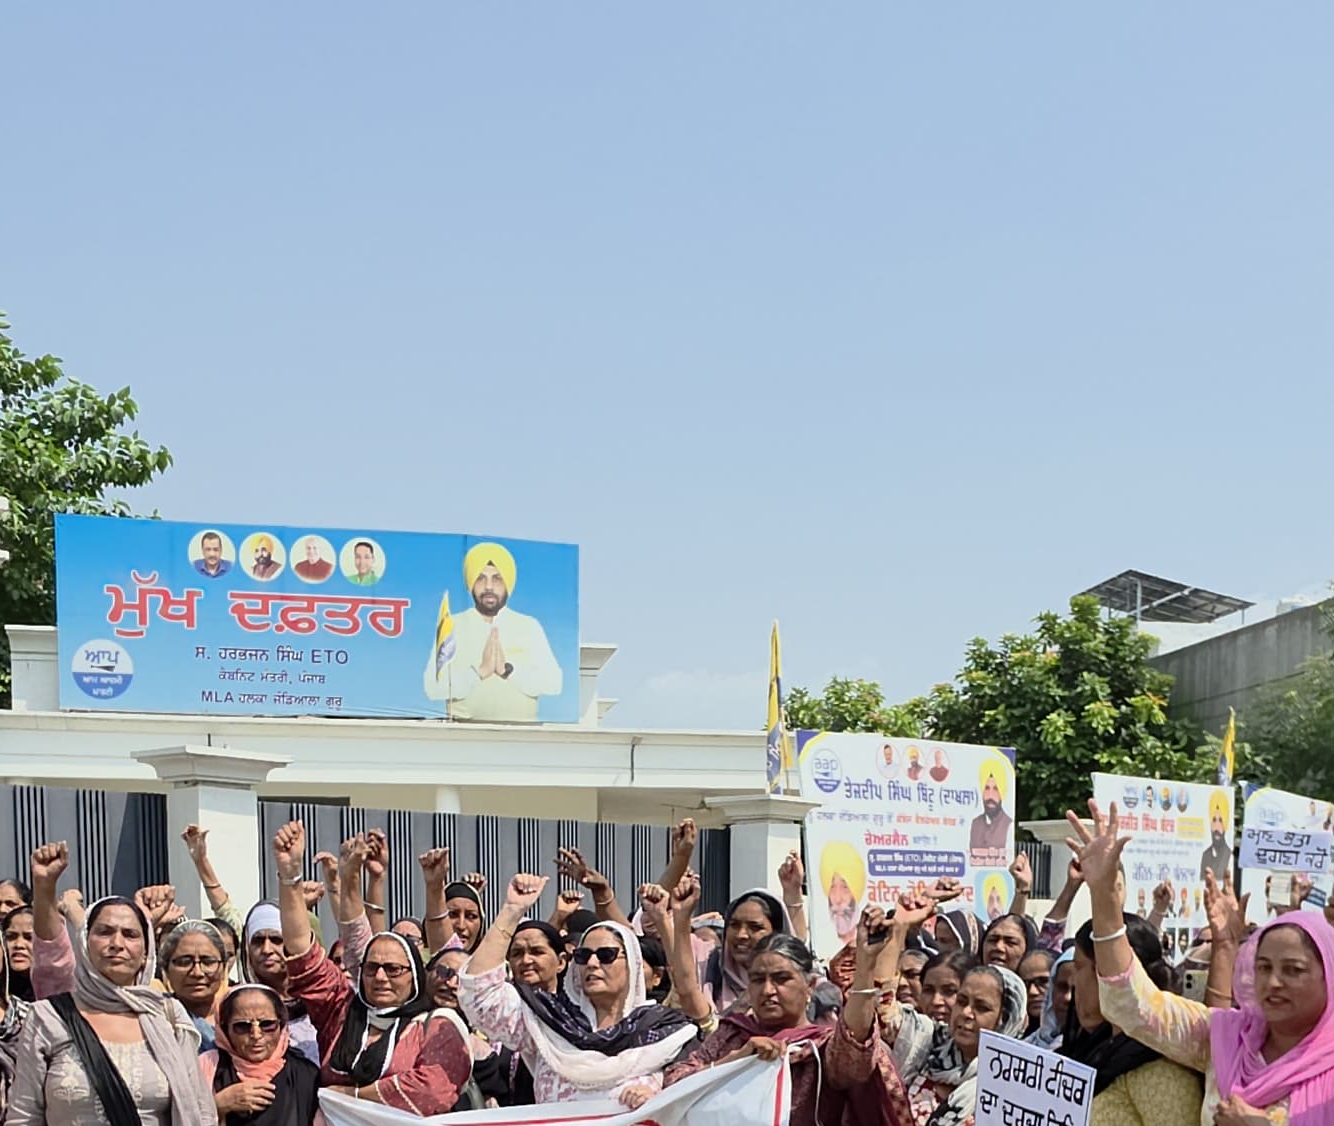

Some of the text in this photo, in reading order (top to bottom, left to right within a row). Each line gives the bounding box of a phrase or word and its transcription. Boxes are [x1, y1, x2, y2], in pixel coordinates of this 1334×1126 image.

[105, 570, 410, 637] ਮੁੱਖ ਦਫ਼ਤਰ
[195, 645, 349, 665] ਸ. ਹਰਭਜਨ ਸਿੰਘ ETO
[201, 690, 234, 703] MLA
[888, 780, 912, 802] ਸਿੰਘ
[986, 1046, 1087, 1106] ਨਰਸਰੀ ਟੀਚਰ
[980, 1089, 999, 1114] ਦਾ
